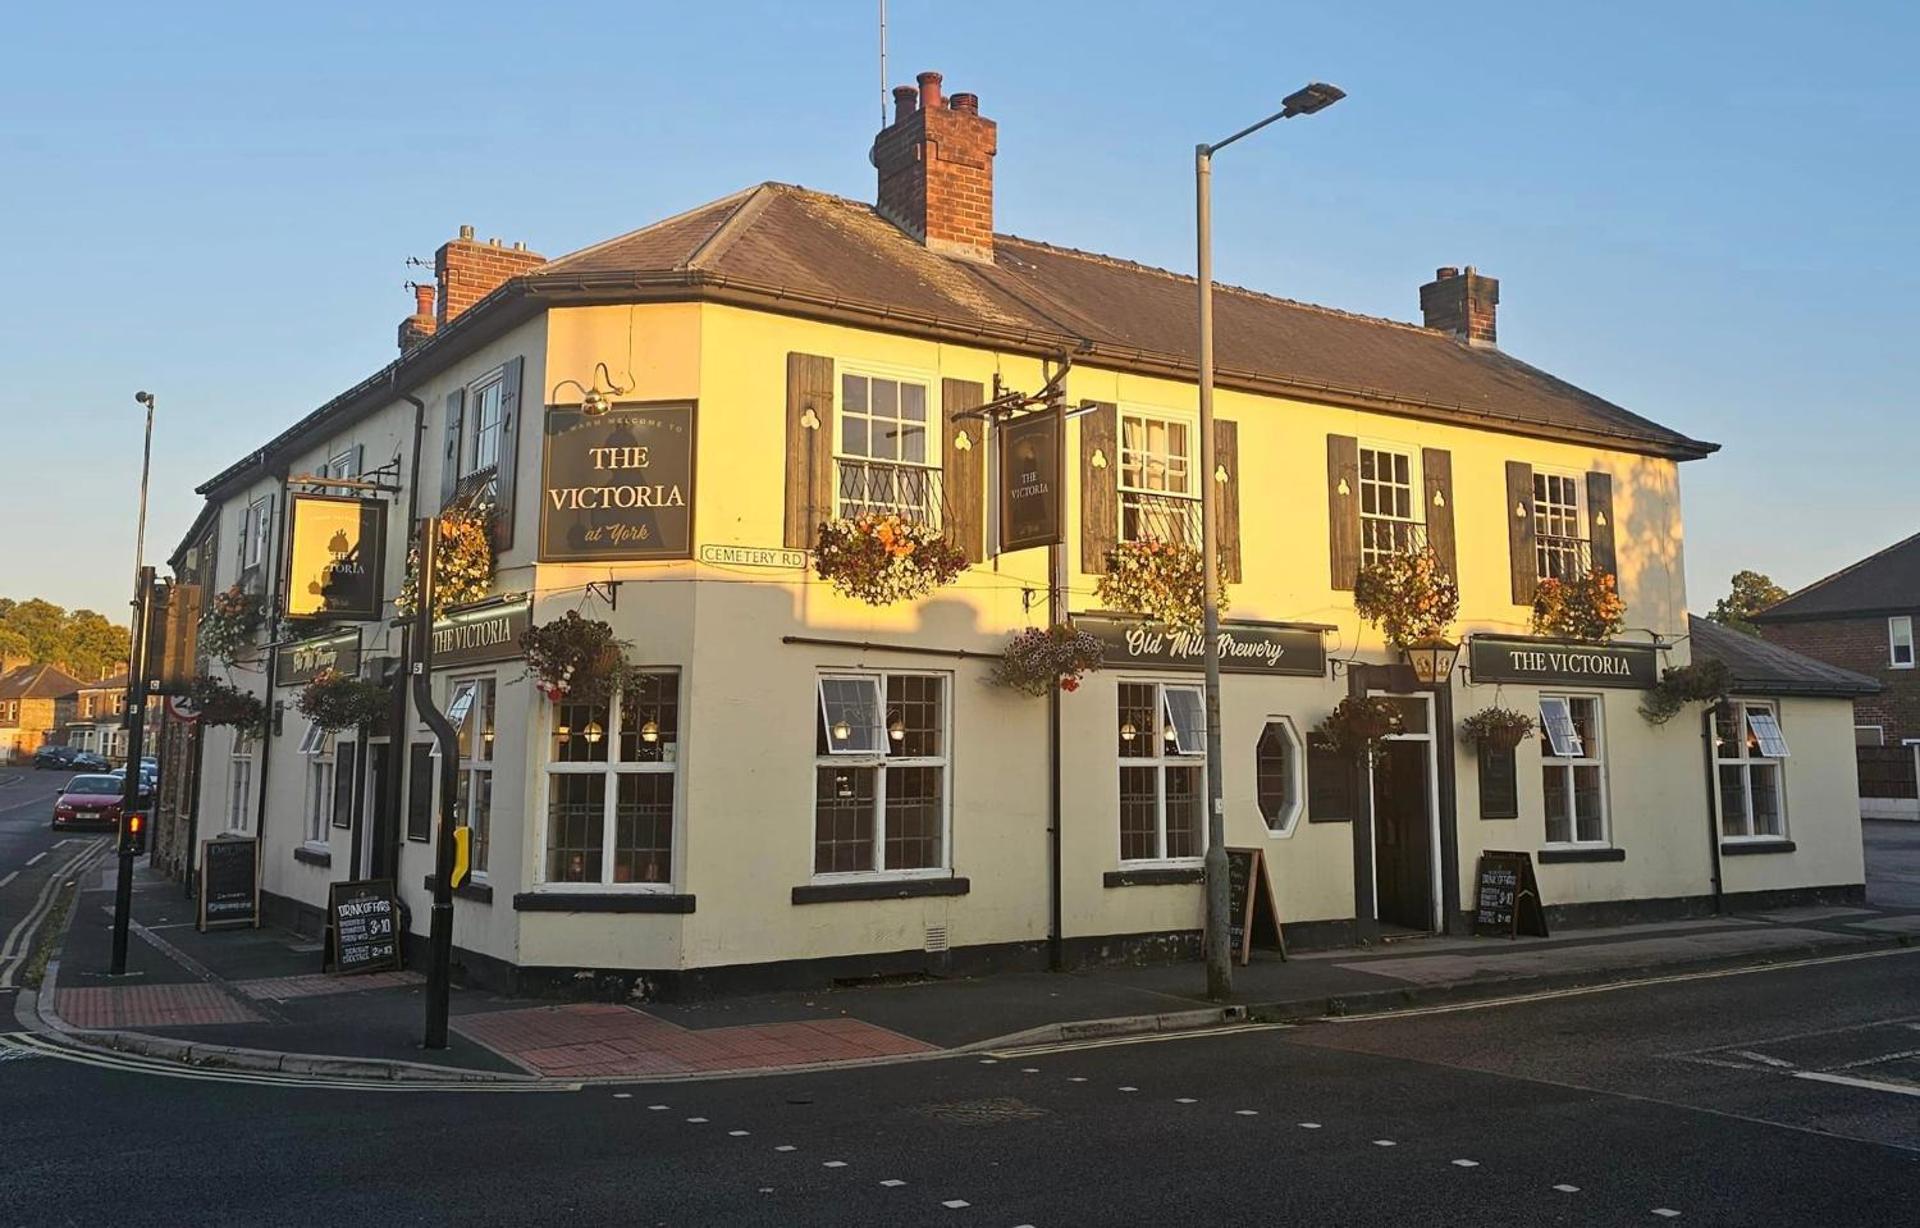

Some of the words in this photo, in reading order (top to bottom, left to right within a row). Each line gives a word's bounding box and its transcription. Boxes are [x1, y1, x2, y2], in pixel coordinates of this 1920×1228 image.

[608, 417, 662, 428] WELCOME
[670, 423, 683, 433] TO
[589, 446, 650, 470] THE
[1021, 471, 1037, 484] THE
[549, 484, 686, 511] VICTORIA
[1011, 483, 1049, 500] VICTORIA
[584, 527, 602, 542] at
[606, 523, 650, 546] York
[704, 547, 776, 564] CEMETERY
[432, 628, 455, 654] THE
[455, 617, 511, 650] VICTORIA
[1125, 630, 1162, 656] Old
[1166, 631, 1205, 659] Mill
[1216, 632, 1284, 667] Brewery
[1510, 651, 1547, 671] THE
[1549, 653, 1631, 676] VICTORIA
